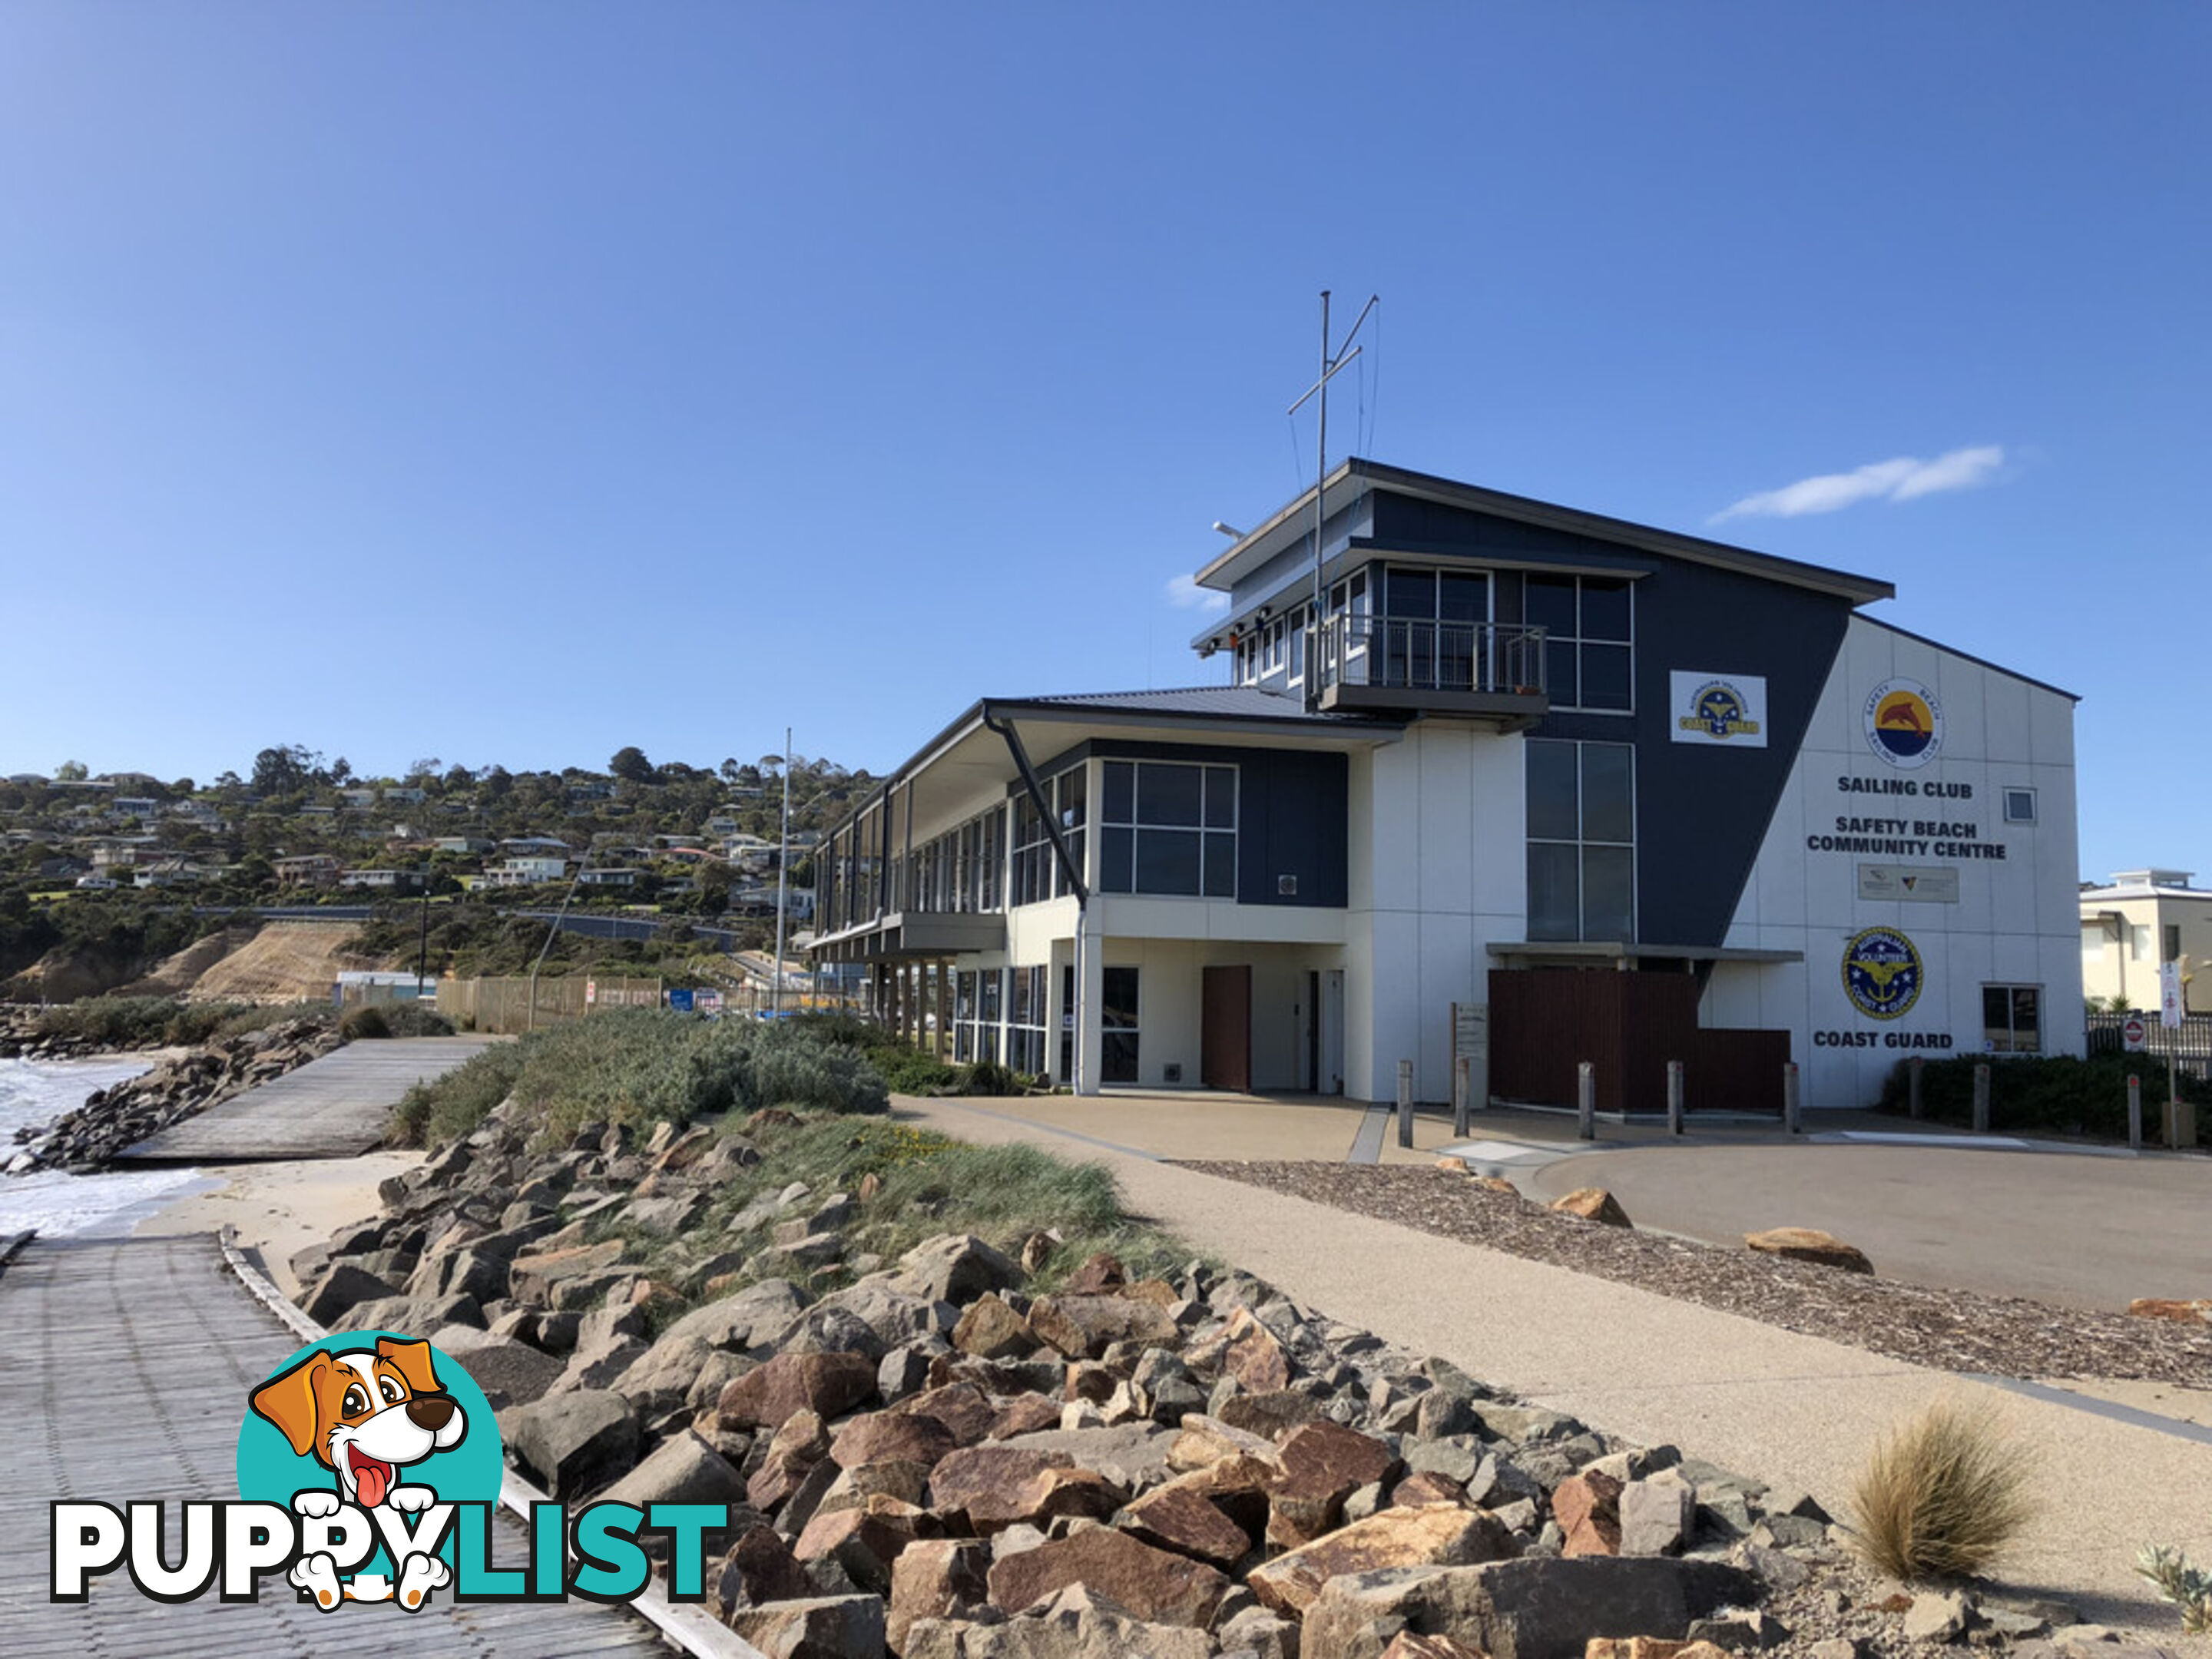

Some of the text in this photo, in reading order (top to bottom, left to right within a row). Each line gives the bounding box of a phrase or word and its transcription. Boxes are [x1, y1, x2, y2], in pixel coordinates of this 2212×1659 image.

[1866, 685, 1940, 720] SAFETY BEACH
[1921, 737, 1939, 760] CLUB
[1838, 777, 1972, 800] SAILING CLUB
[1836, 816, 1977, 839] SAFETY BEACH
[1807, 835, 2006, 859] COMMUNITY CENTRE
[1813, 1030, 1953, 1049] COAST GUARD
